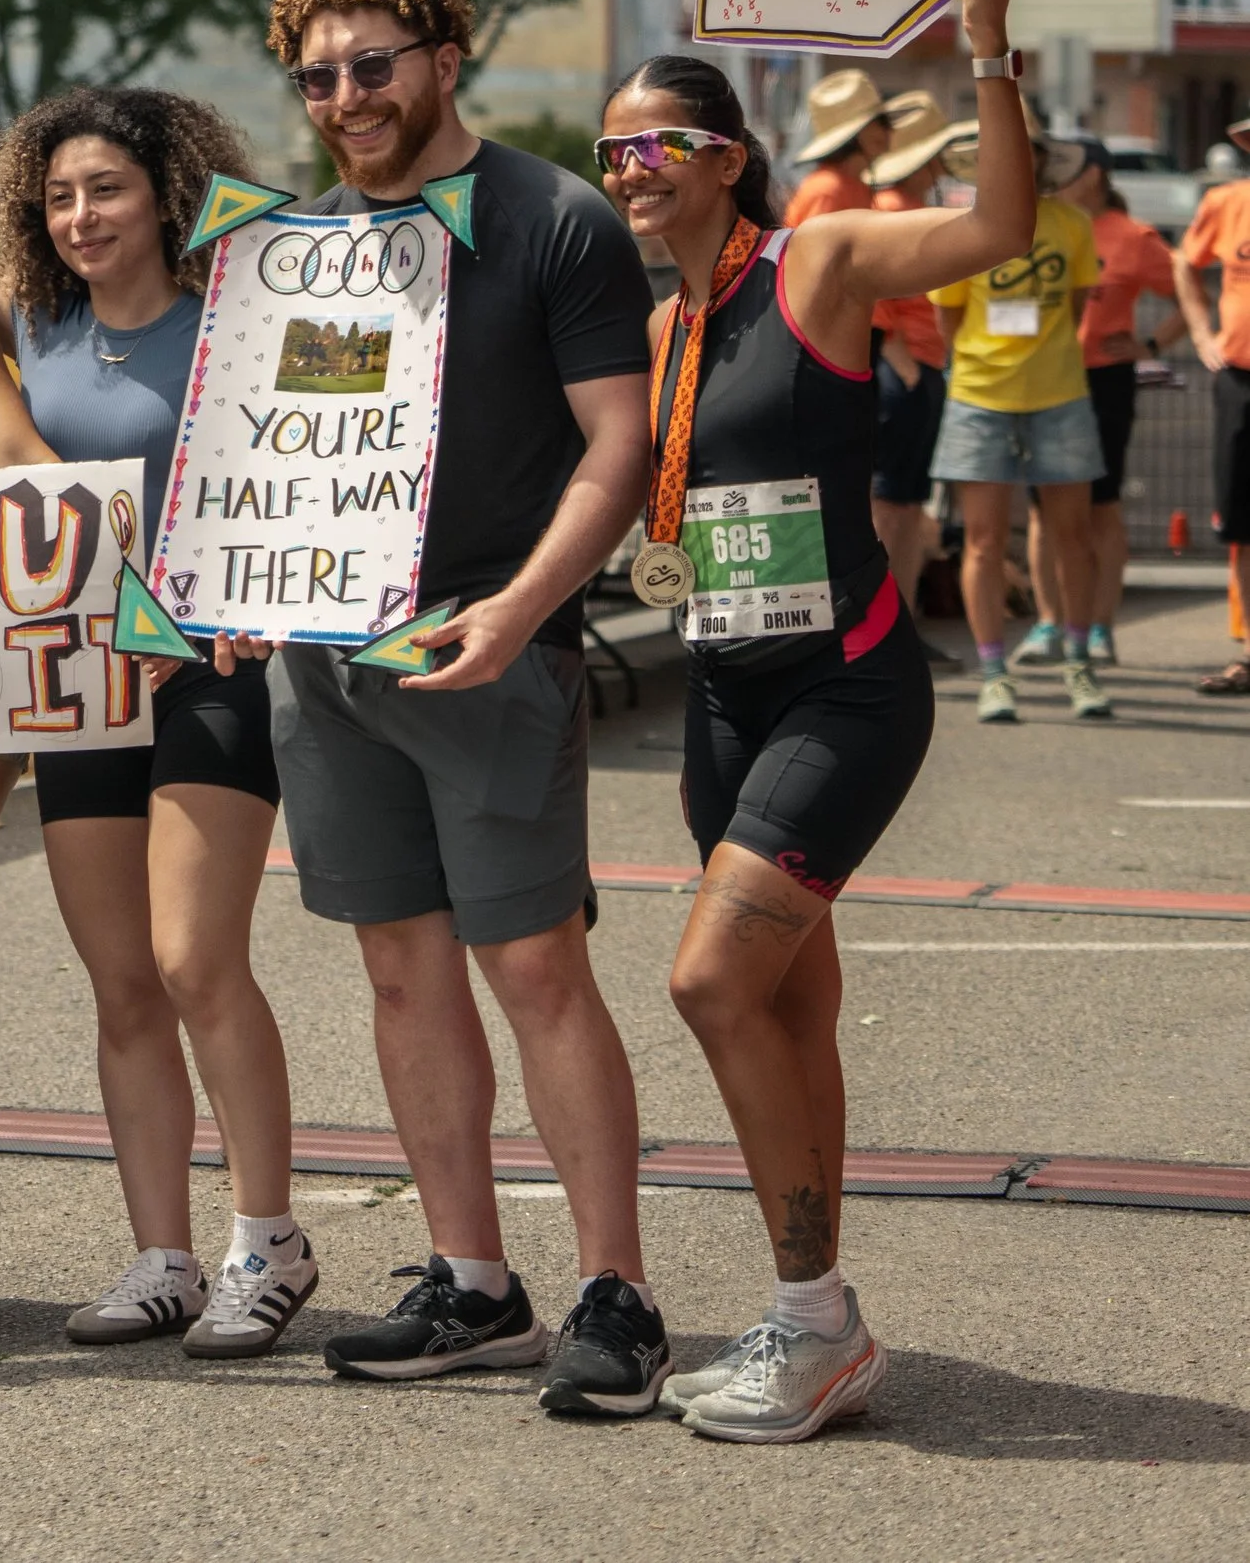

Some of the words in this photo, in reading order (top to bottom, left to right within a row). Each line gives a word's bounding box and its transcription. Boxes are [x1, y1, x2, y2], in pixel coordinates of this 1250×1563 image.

[239, 401, 411, 459] YOU'RE
[711, 522, 772, 564] 685
[219, 545, 368, 605] THERE
[729, 570, 755, 587] AMI
[762, 596, 780, 604] 70
[700, 616, 727, 635] FOOD
[763, 609, 813, 631] DRINK
